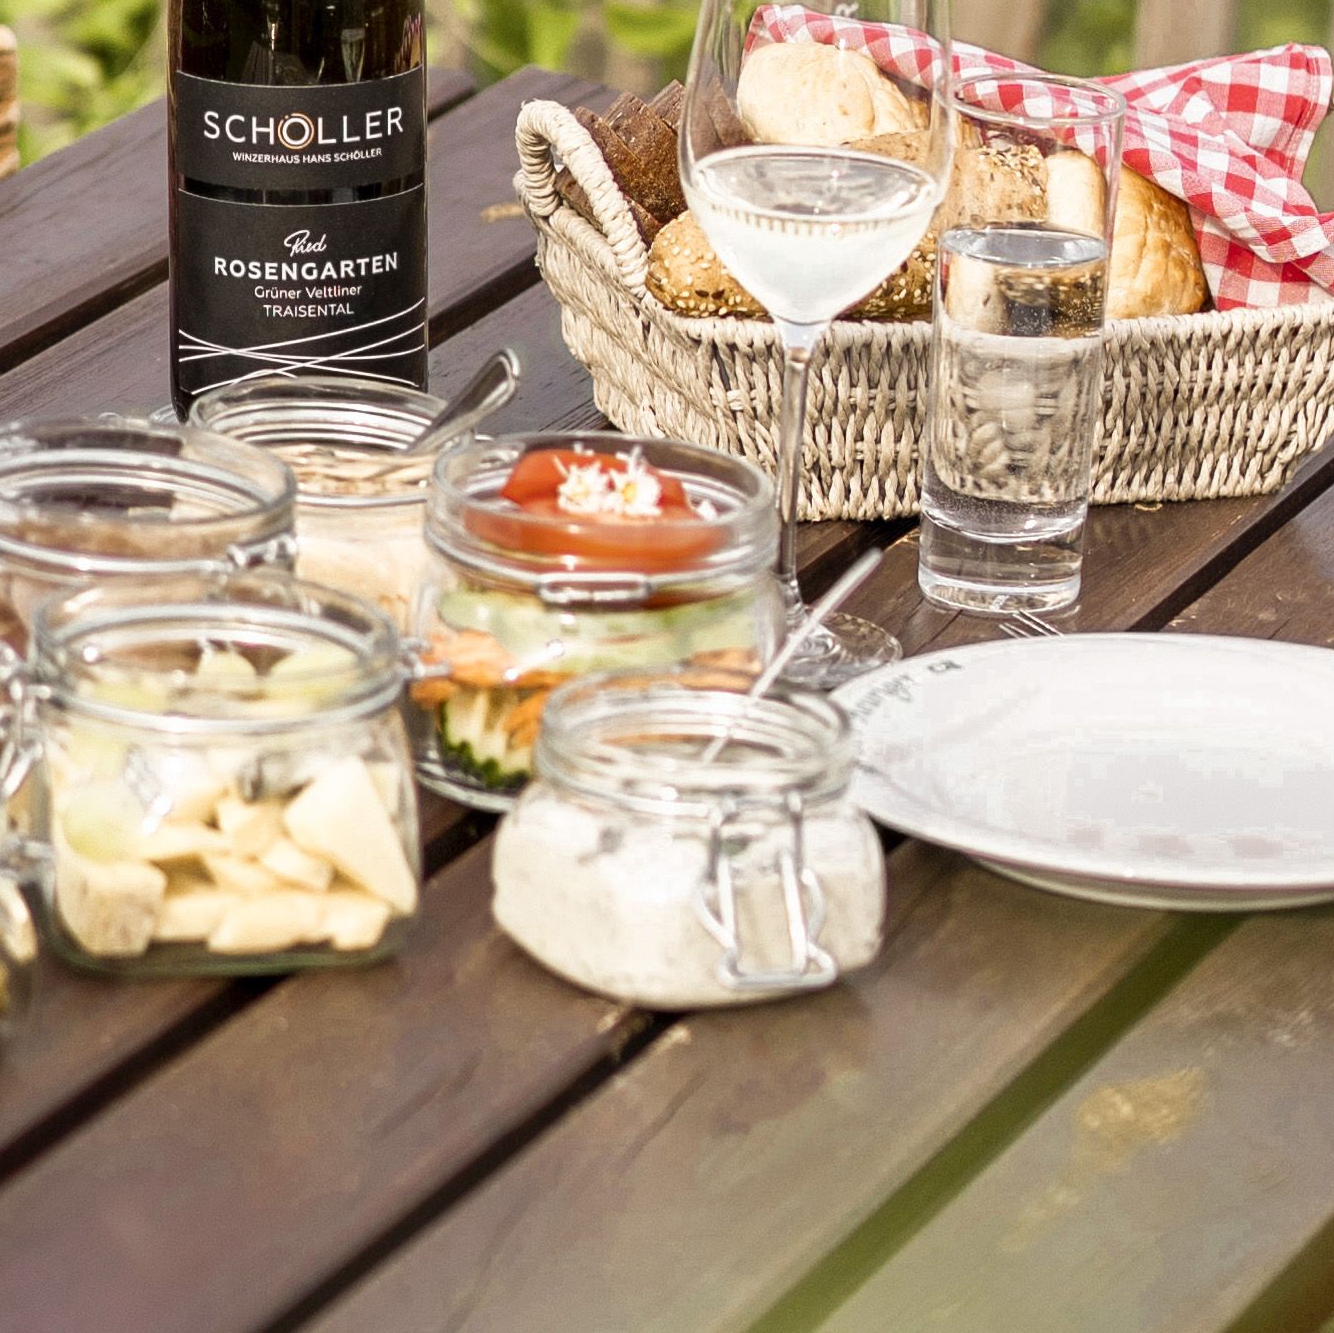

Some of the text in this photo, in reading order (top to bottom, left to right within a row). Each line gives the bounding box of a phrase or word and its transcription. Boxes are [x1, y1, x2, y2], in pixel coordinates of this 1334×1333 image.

[232, 151, 300, 164] WINZERHAUS
[302, 153, 332, 164] HANS
[283, 229, 327, 257] Ried
[214, 251, 398, 281] ROSENGARTEN
[254, 284, 363, 299] Grüner Veltliner
[263, 302, 355, 318] TRAISENTAL
